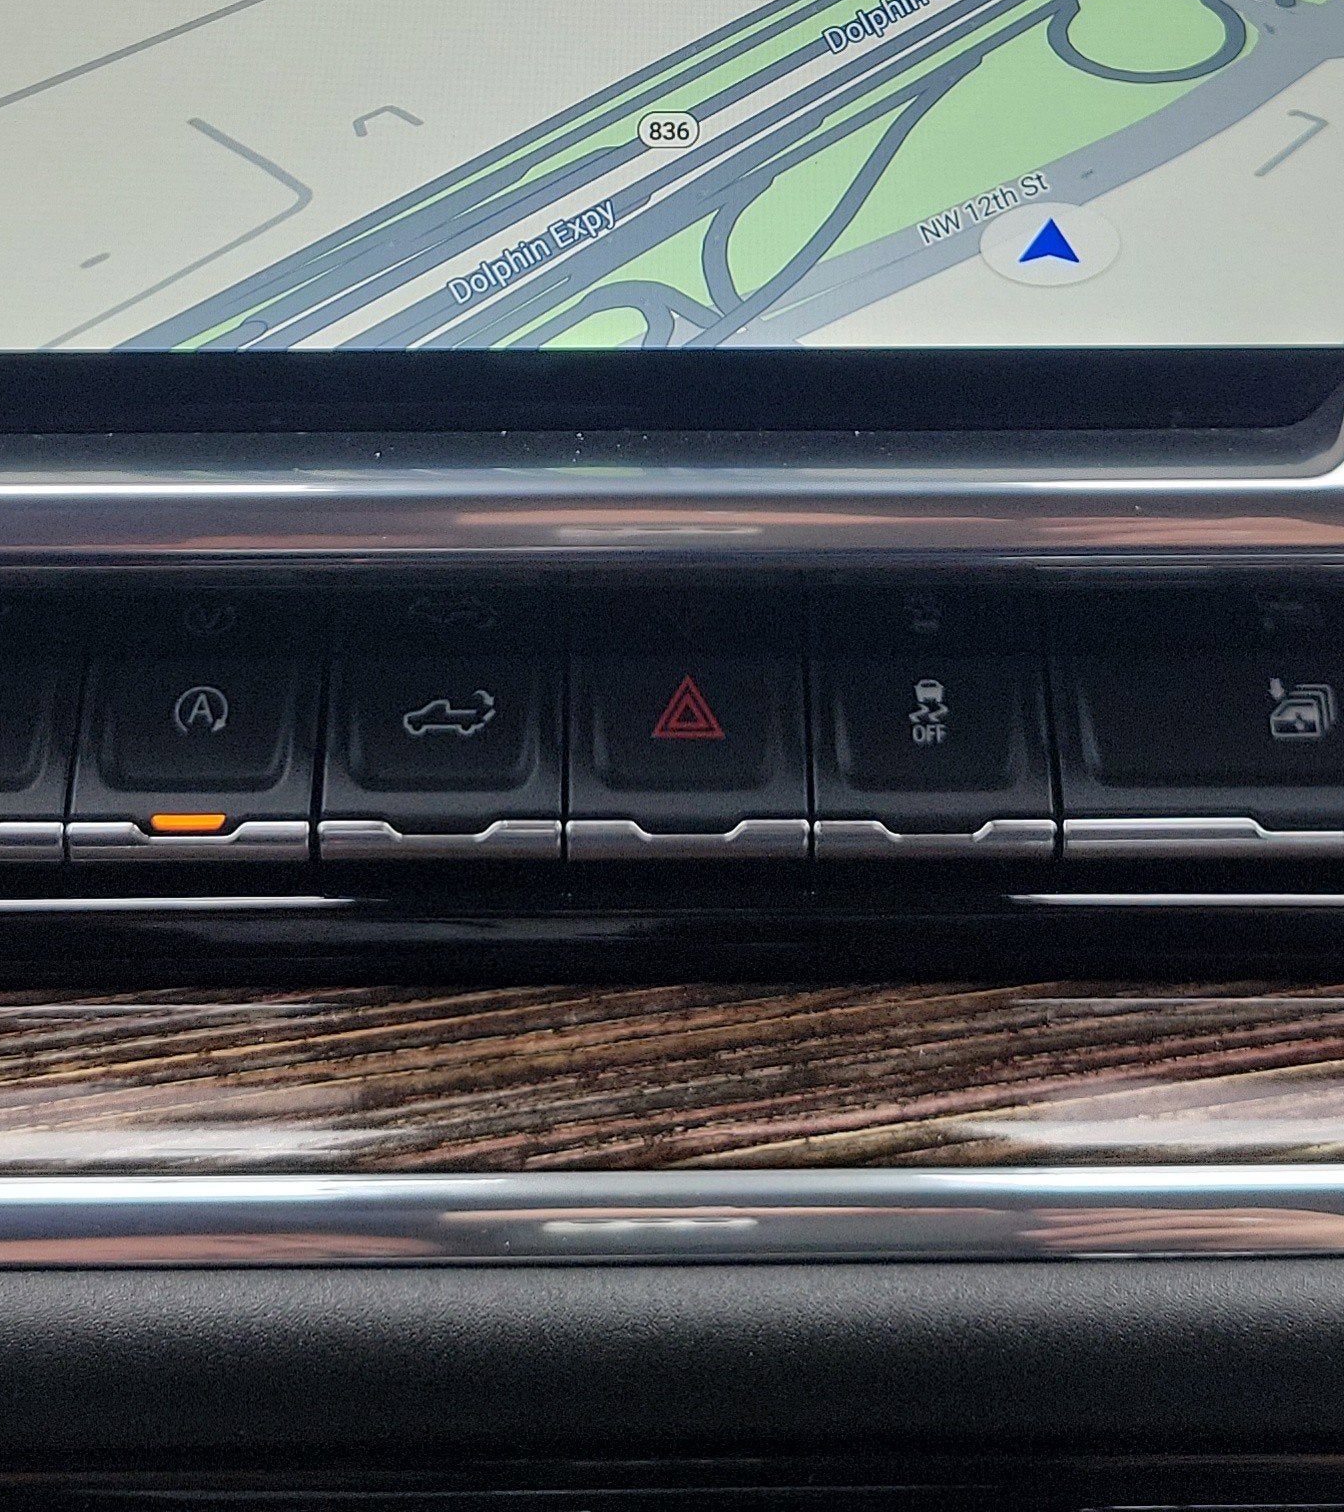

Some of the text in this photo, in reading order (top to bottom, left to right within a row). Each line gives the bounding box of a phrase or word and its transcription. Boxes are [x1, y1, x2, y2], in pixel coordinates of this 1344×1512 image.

[647, 120, 691, 142] 836
[917, 172, 1050, 246] NW 12th St
[446, 197, 618, 305] Dolphin Expy
[912, 723, 947, 743] OFF
